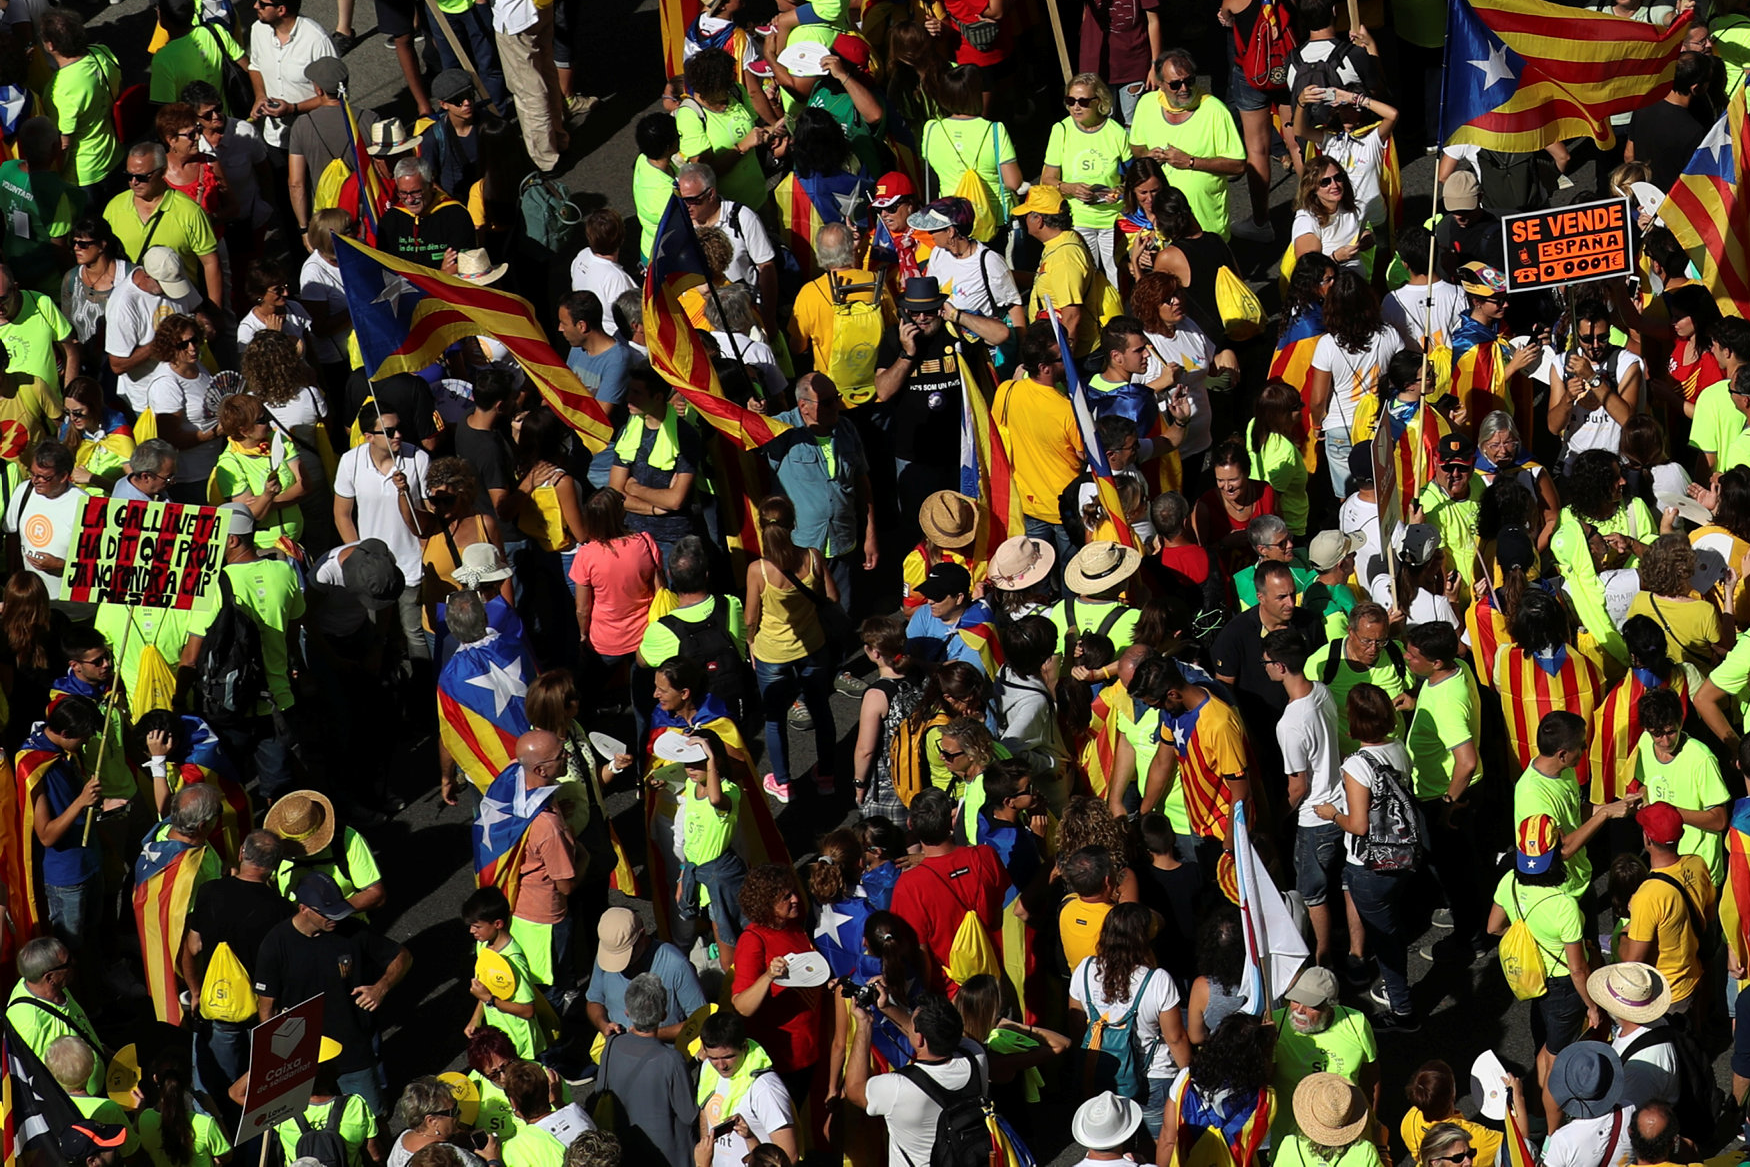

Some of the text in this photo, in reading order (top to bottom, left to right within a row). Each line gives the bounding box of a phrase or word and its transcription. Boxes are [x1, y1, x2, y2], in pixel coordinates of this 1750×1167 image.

[1082, 159, 1096, 171] Sí
[1512, 205, 1623, 242] SE VENDE
[1542, 234, 1619, 257] ESPAÑA
[81, 504, 107, 528] LA
[76, 532, 101, 559] HA
[140, 536, 175, 565] QUE
[68, 562, 89, 587] JA
[92, 563, 113, 588] NO
[265, 1058, 302, 1082] Caixa
[256, 1083, 268, 1094] de
